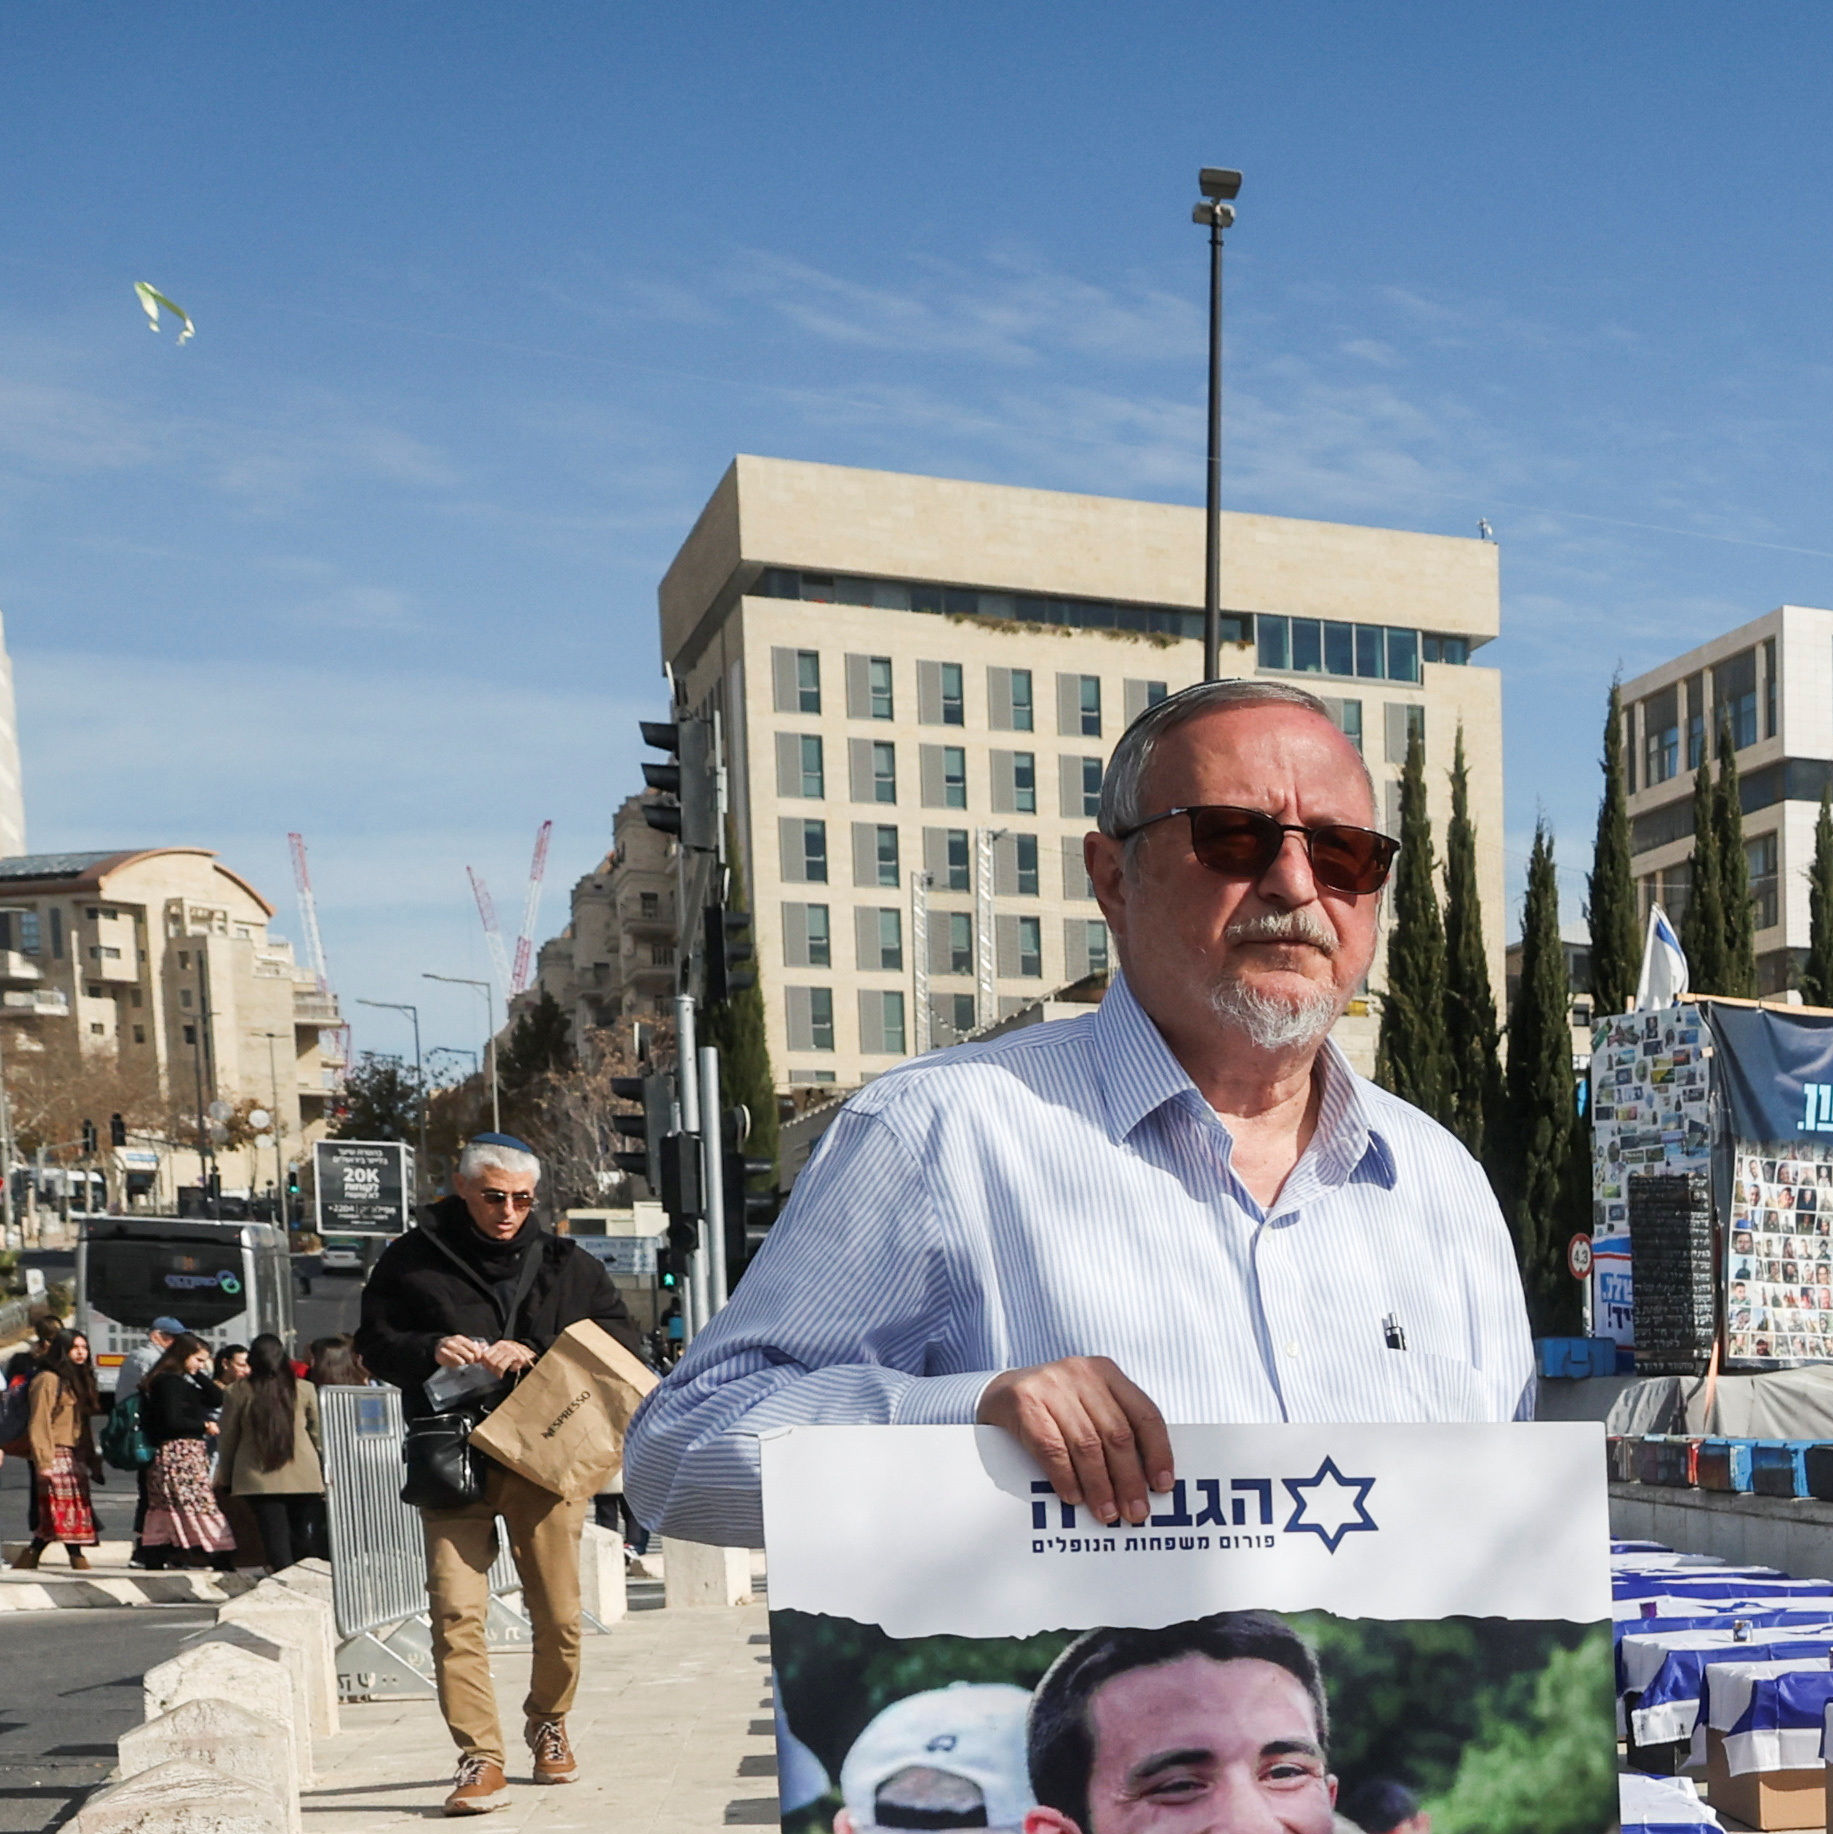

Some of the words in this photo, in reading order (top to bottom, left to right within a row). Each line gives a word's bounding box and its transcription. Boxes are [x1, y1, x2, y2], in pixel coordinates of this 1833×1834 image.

[343, 1167, 380, 1183] 20K
[541, 1390, 591, 1439] NESPRESSO
[1030, 1478, 1274, 1530] הגבה
[1031, 1536, 1116, 1554] הנופלים
[1124, 1536, 1211, 1552] משפחות
[1219, 1535, 1276, 1550] פורום
